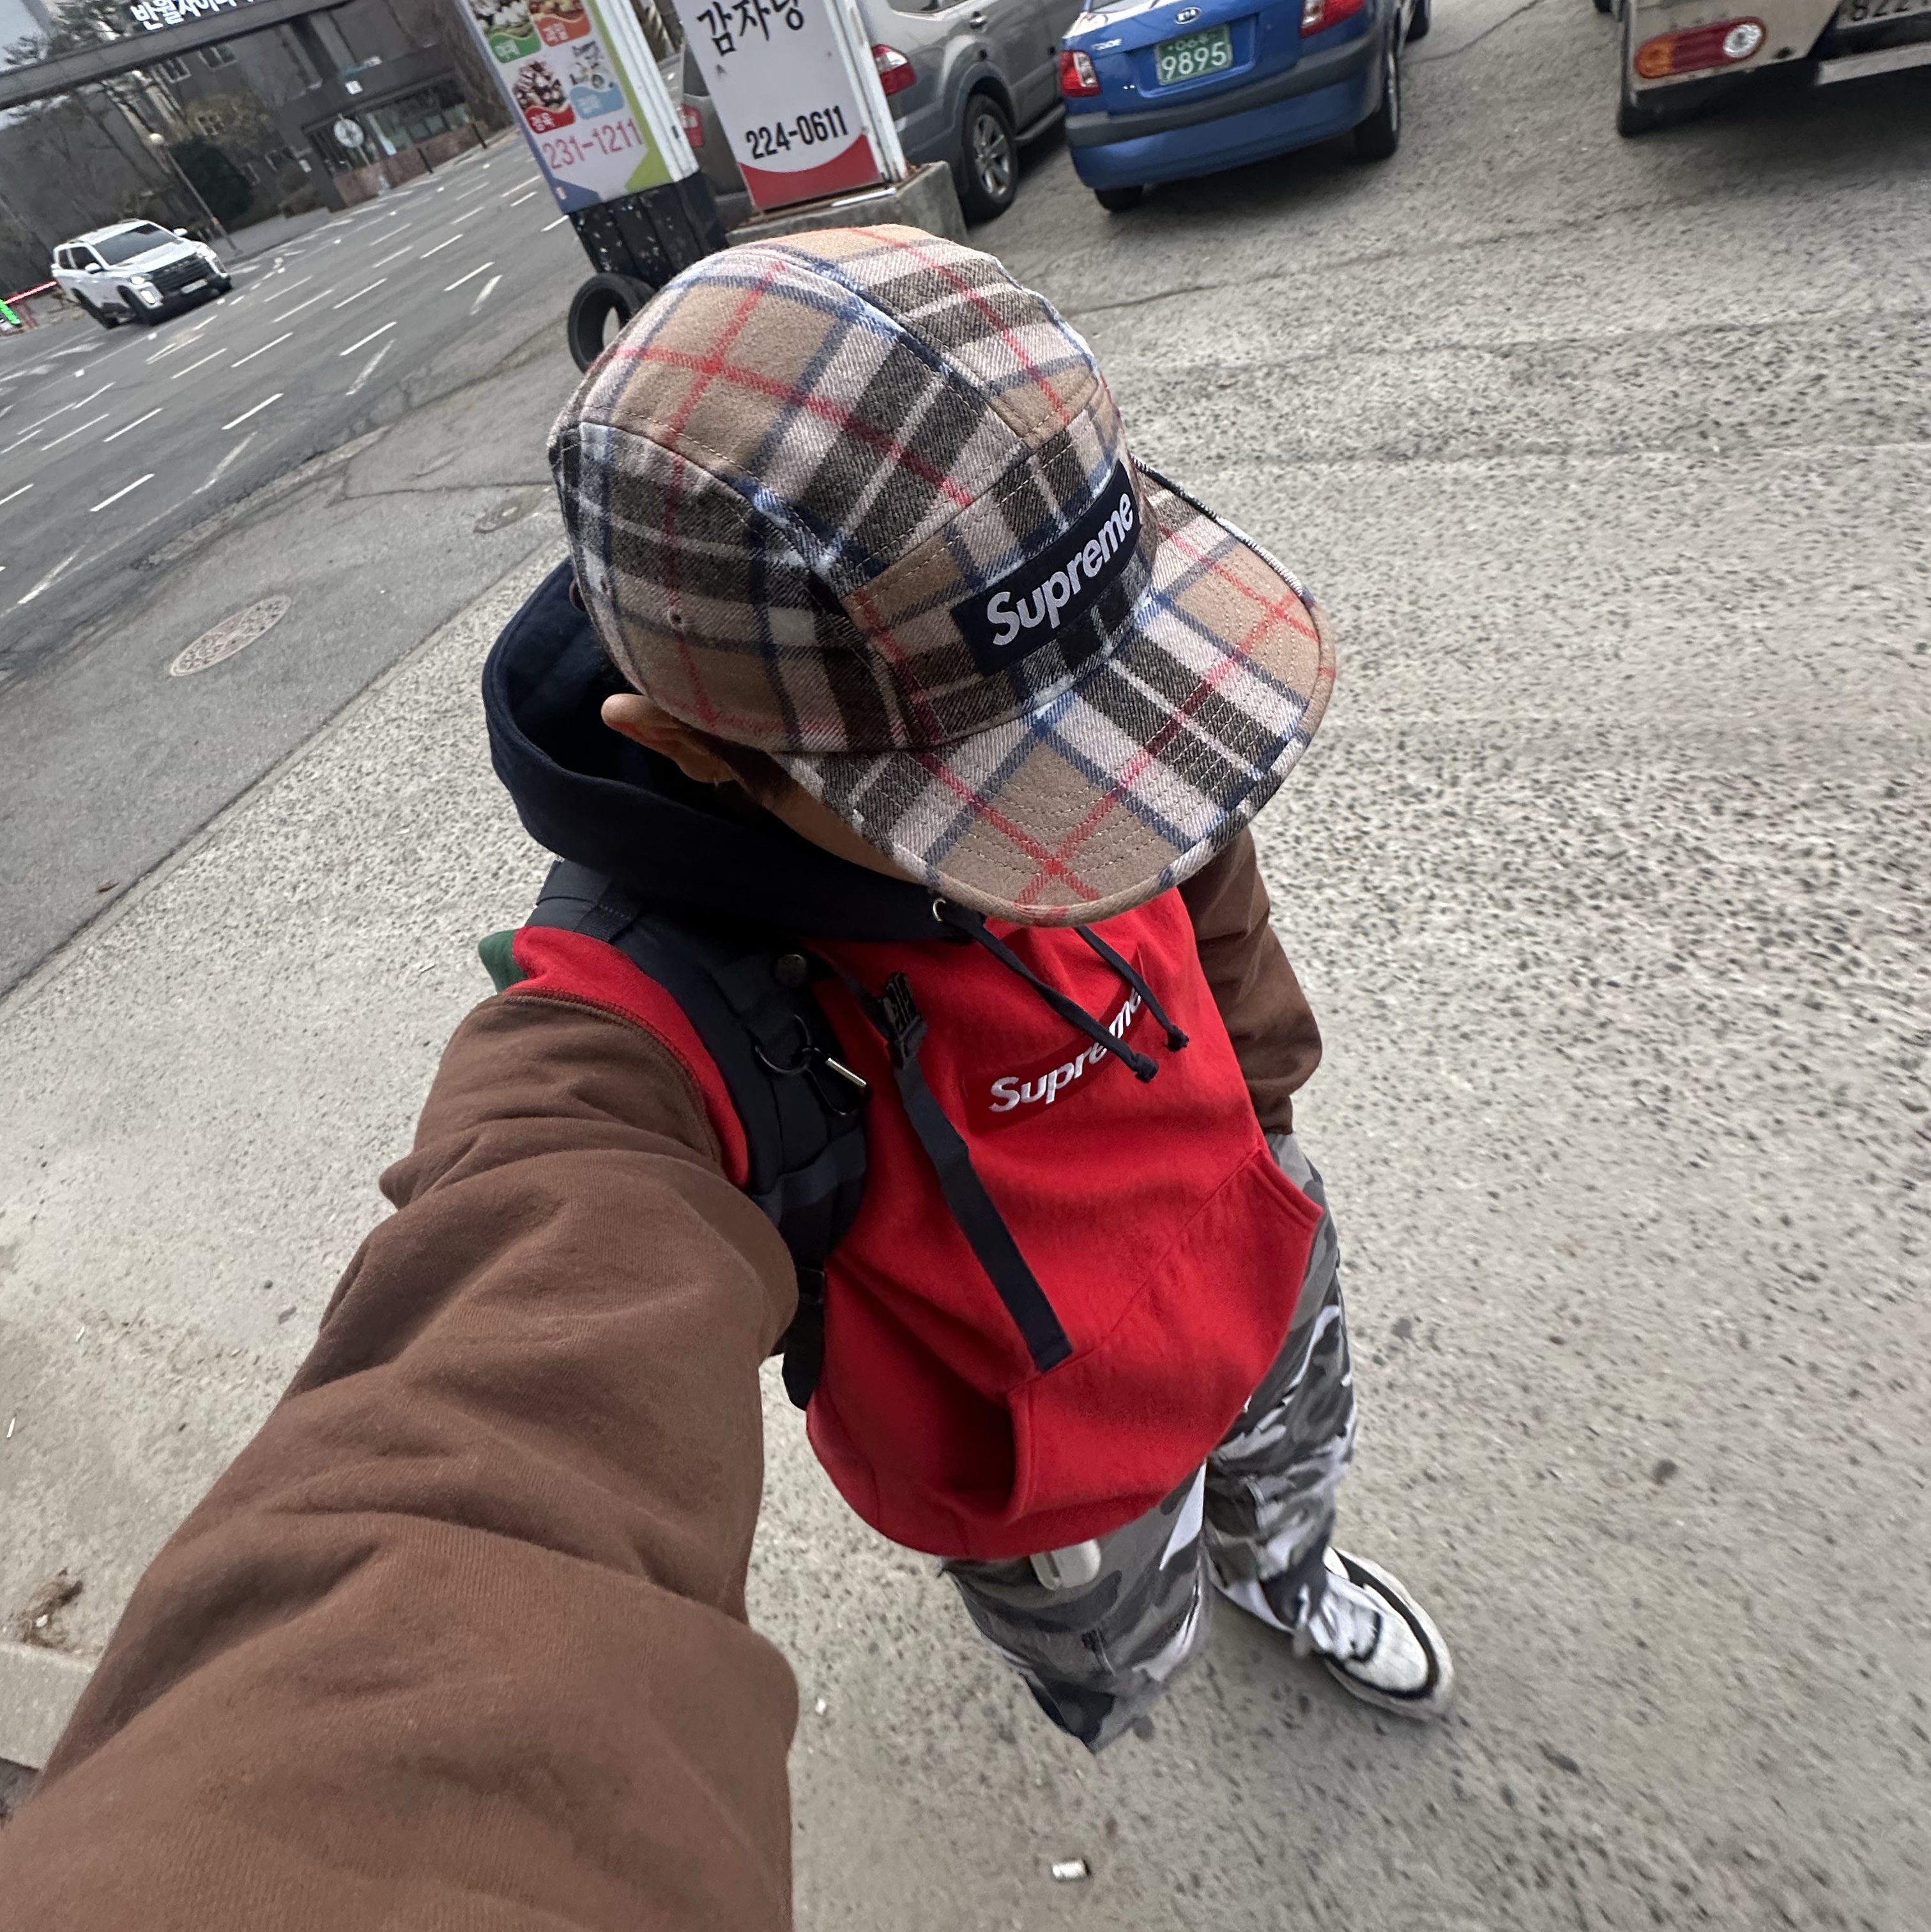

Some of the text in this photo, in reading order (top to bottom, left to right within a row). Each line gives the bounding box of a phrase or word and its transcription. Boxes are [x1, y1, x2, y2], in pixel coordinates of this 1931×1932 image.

[1162, 41, 1228, 81] 9895
[542, 118, 643, 170] 231-1211
[745, 105, 848, 160] 224-0611
[987, 493, 1133, 646] Supreme
